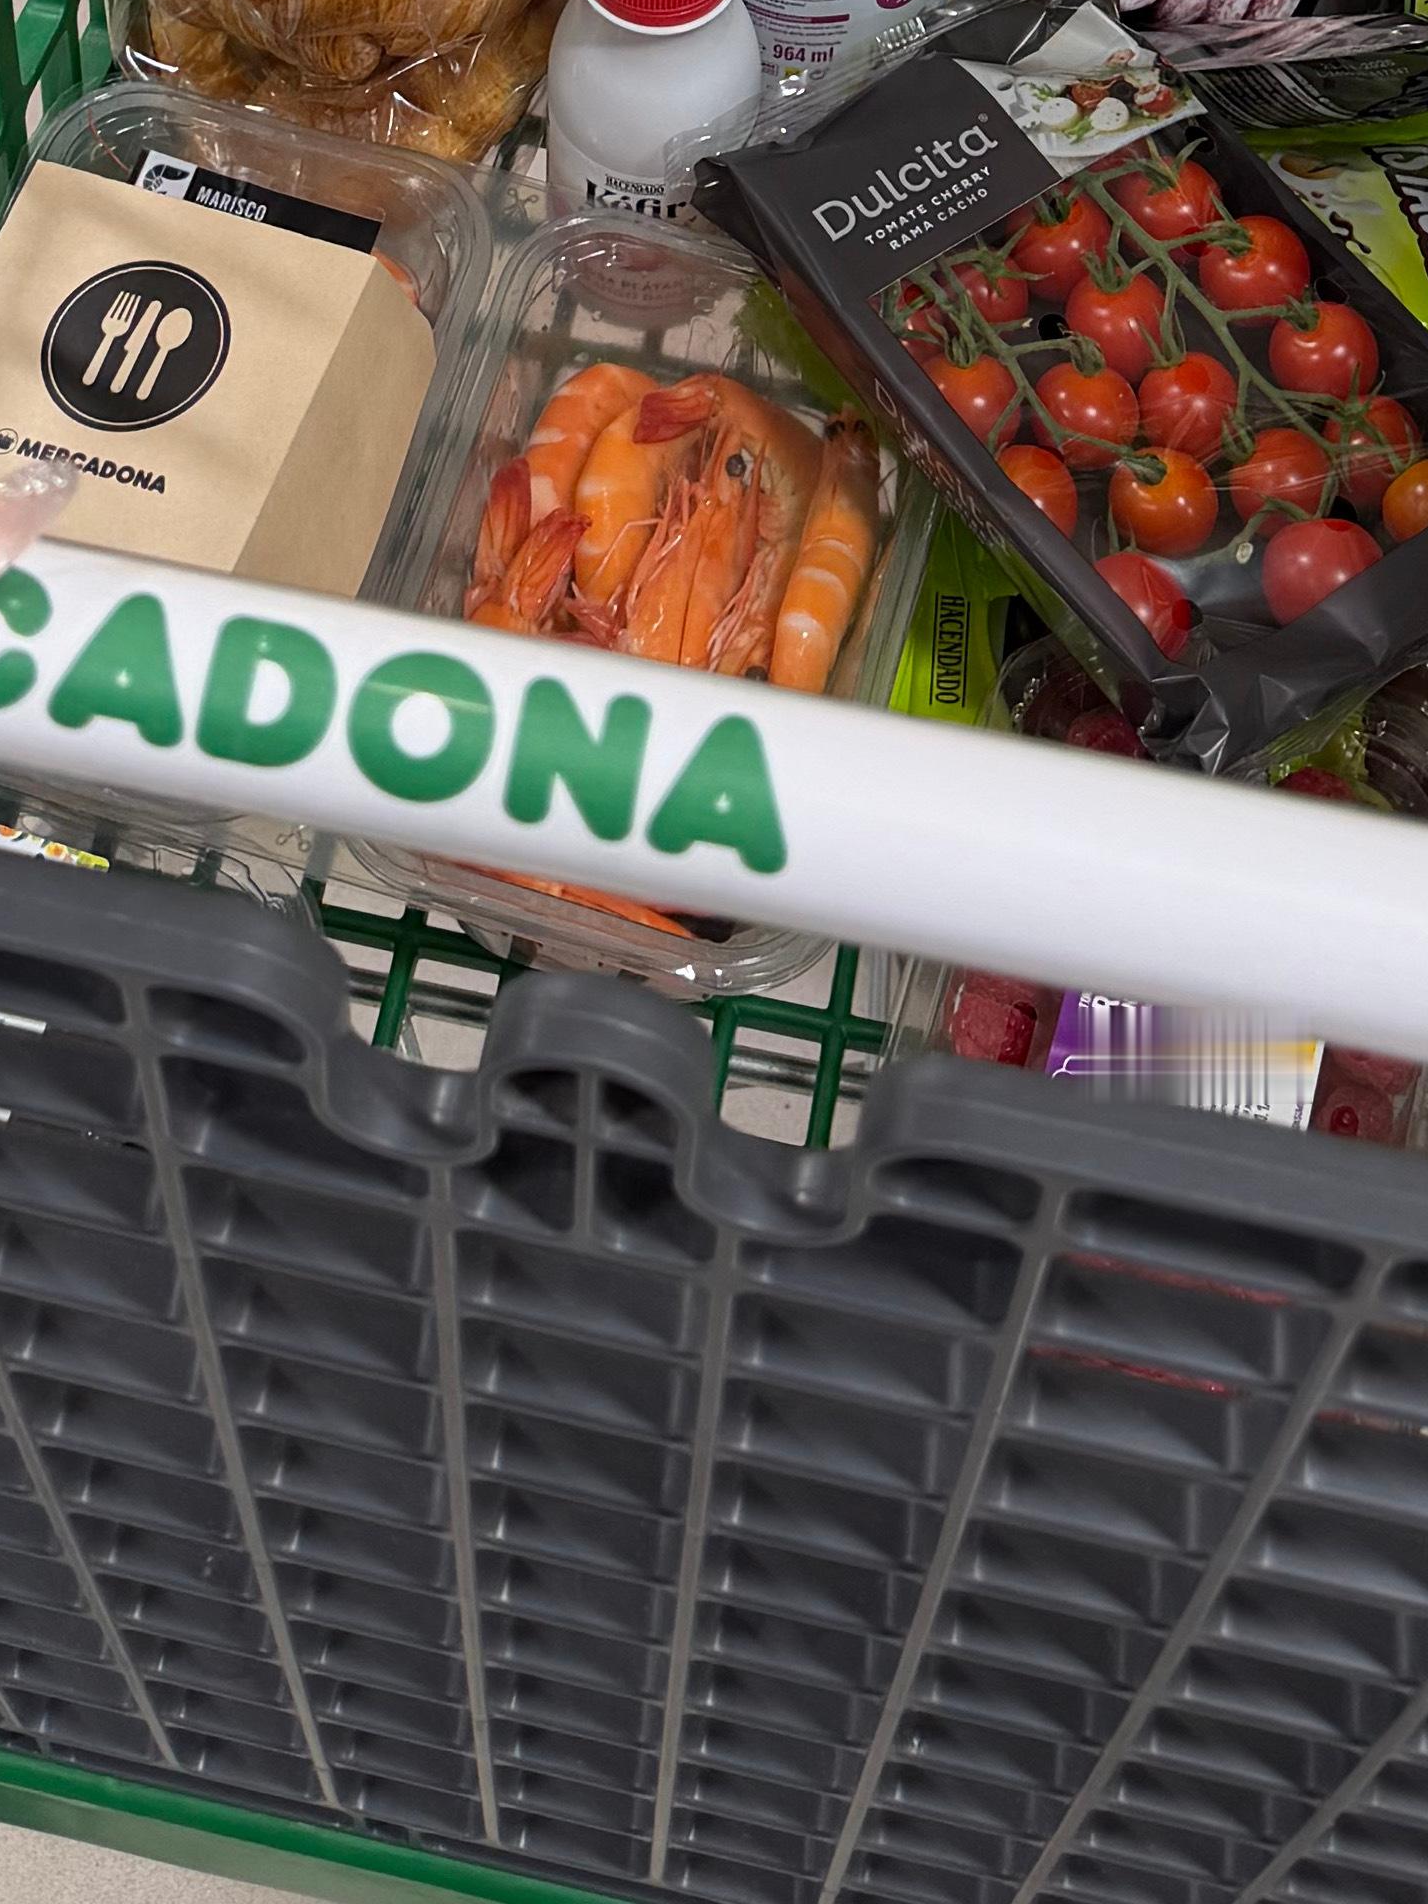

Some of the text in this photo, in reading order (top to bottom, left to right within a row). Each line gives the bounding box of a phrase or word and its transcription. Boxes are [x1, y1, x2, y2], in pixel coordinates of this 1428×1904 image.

[772, 44, 835, 63] 964 ml
[194, 184, 268, 223] MARISCO
[811, 124, 999, 242] Dulcita
[863, 165, 992, 246] TOMATE CHERRY
[888, 187, 989, 251] RAMA CACHO
[15, 437, 167, 496] MERCADONA
[934, 593, 965, 706] HACENDADO
